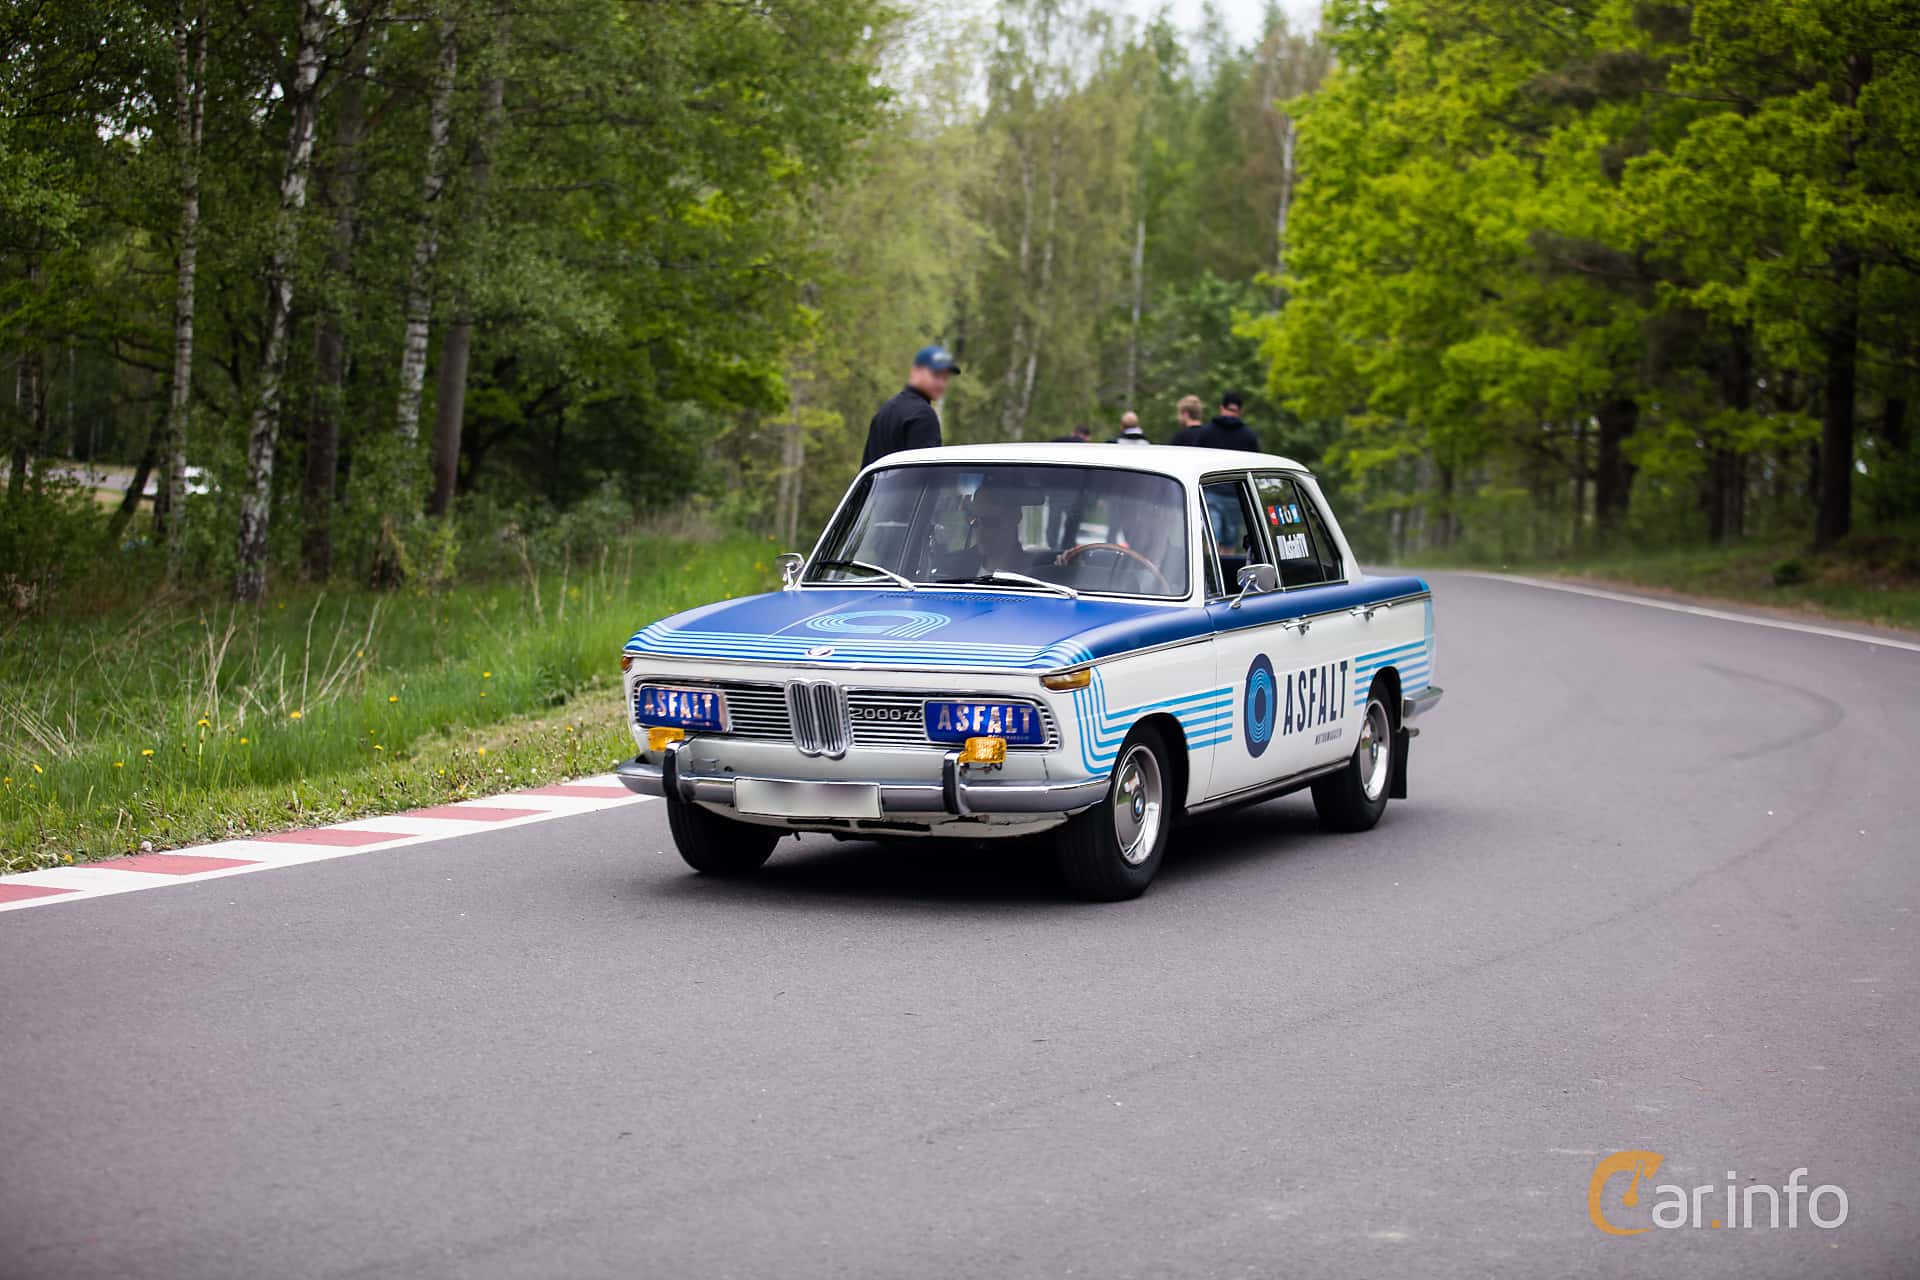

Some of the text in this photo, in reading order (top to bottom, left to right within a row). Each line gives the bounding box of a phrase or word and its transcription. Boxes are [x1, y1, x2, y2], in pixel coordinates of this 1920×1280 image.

[643, 687, 714, 720] ASFALT
[1283, 660, 1348, 737] ASFALT
[936, 703, 1033, 734] ASFALT
